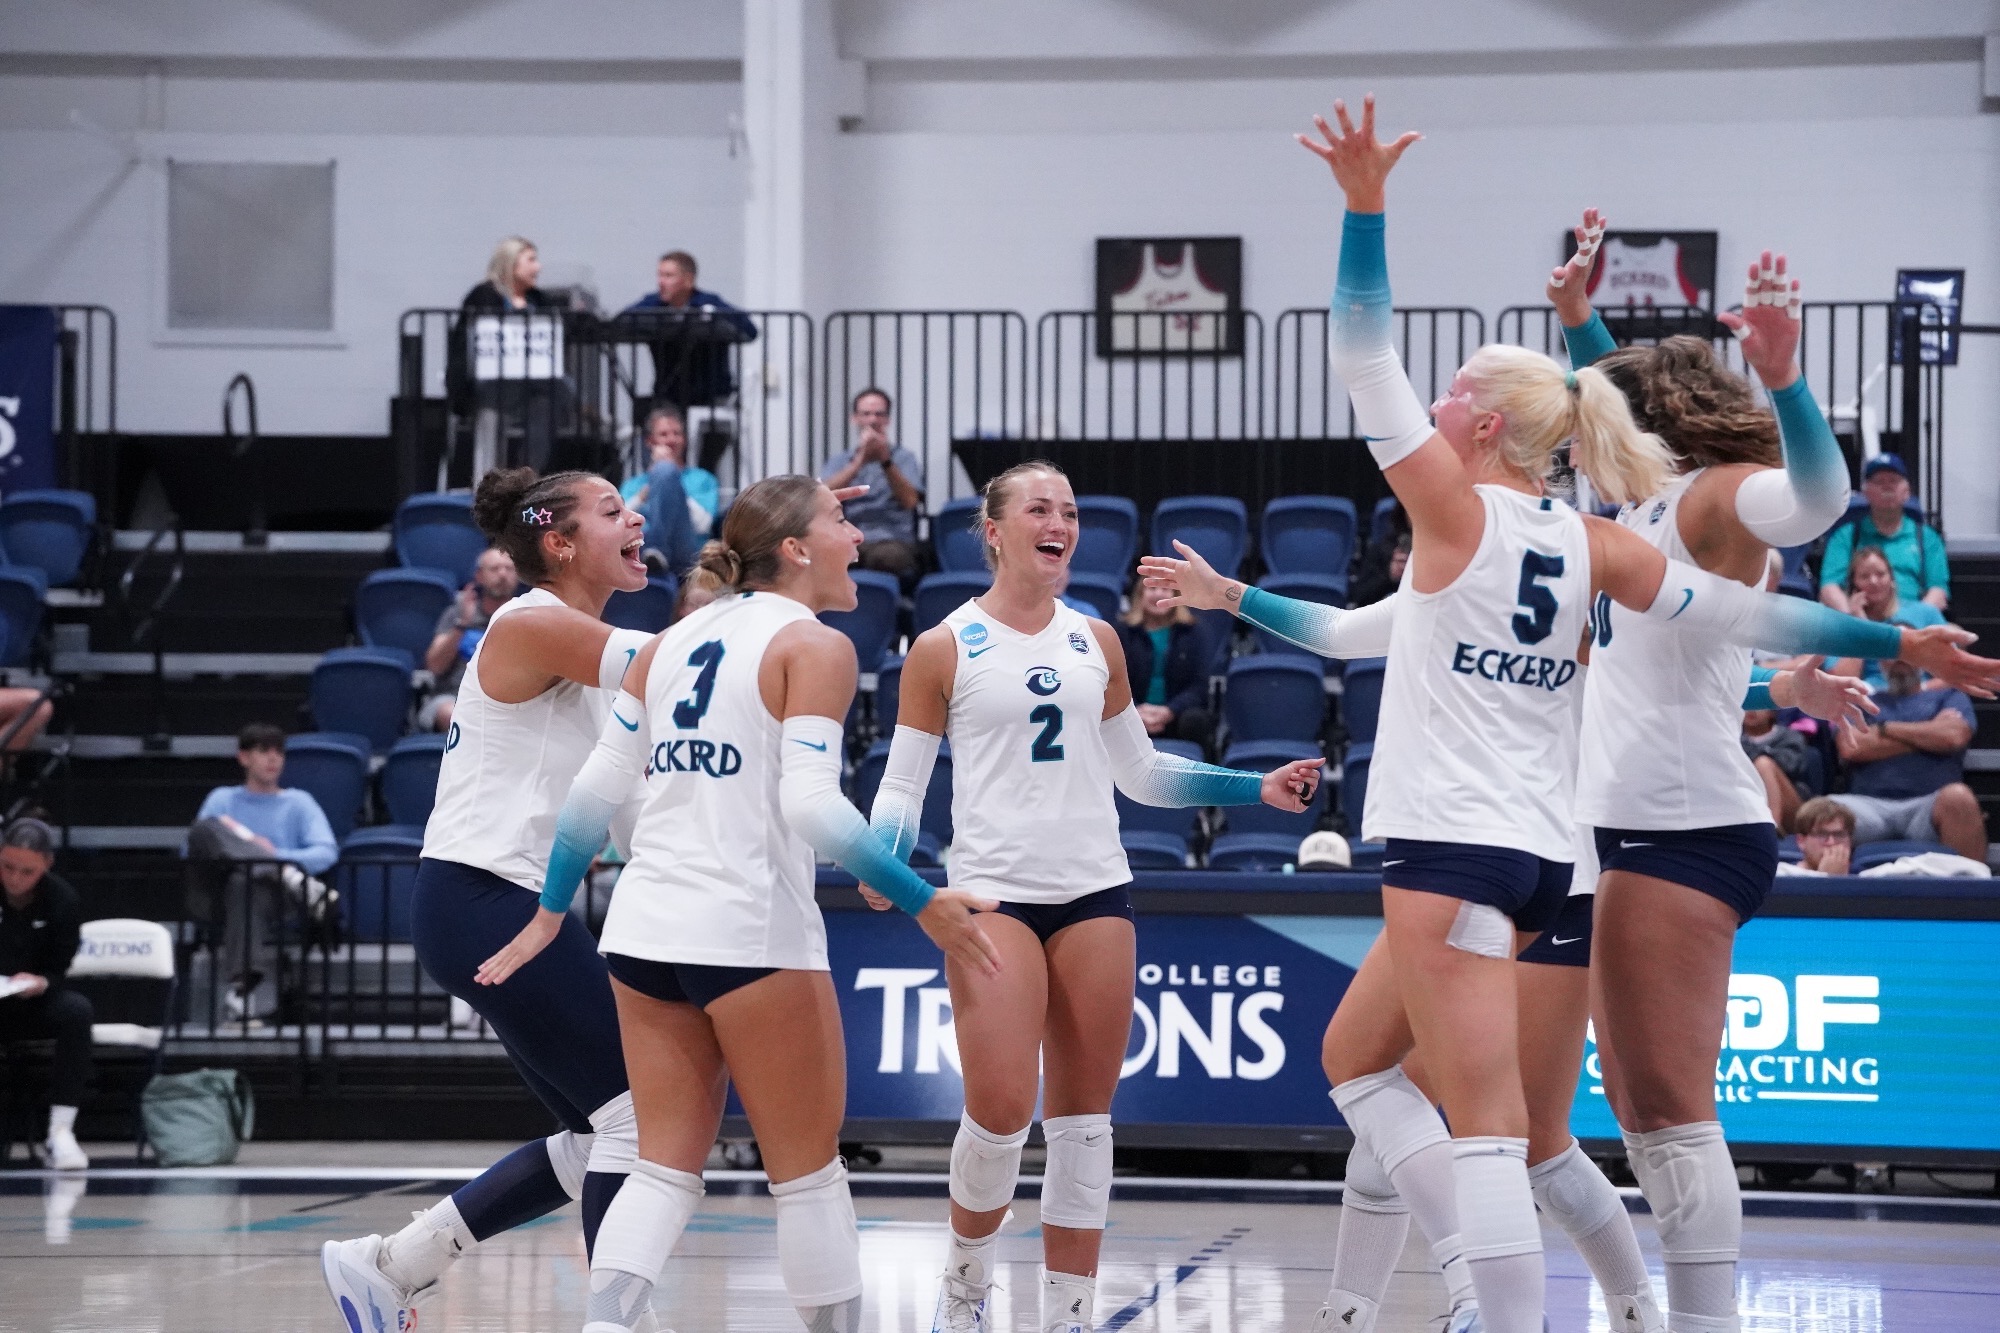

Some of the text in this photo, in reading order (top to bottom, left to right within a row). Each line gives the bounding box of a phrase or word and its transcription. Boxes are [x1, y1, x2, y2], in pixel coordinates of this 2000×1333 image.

[1512, 548, 1565, 646] 5
[964, 630, 987, 641] NCAA
[672, 638, 726, 730] 3
[1043, 671, 1062, 684] EC
[1452, 641, 1577, 691] ECKERD
[1029, 703, 1065, 763] 2
[1138, 963, 1282, 987] OLLEGE
